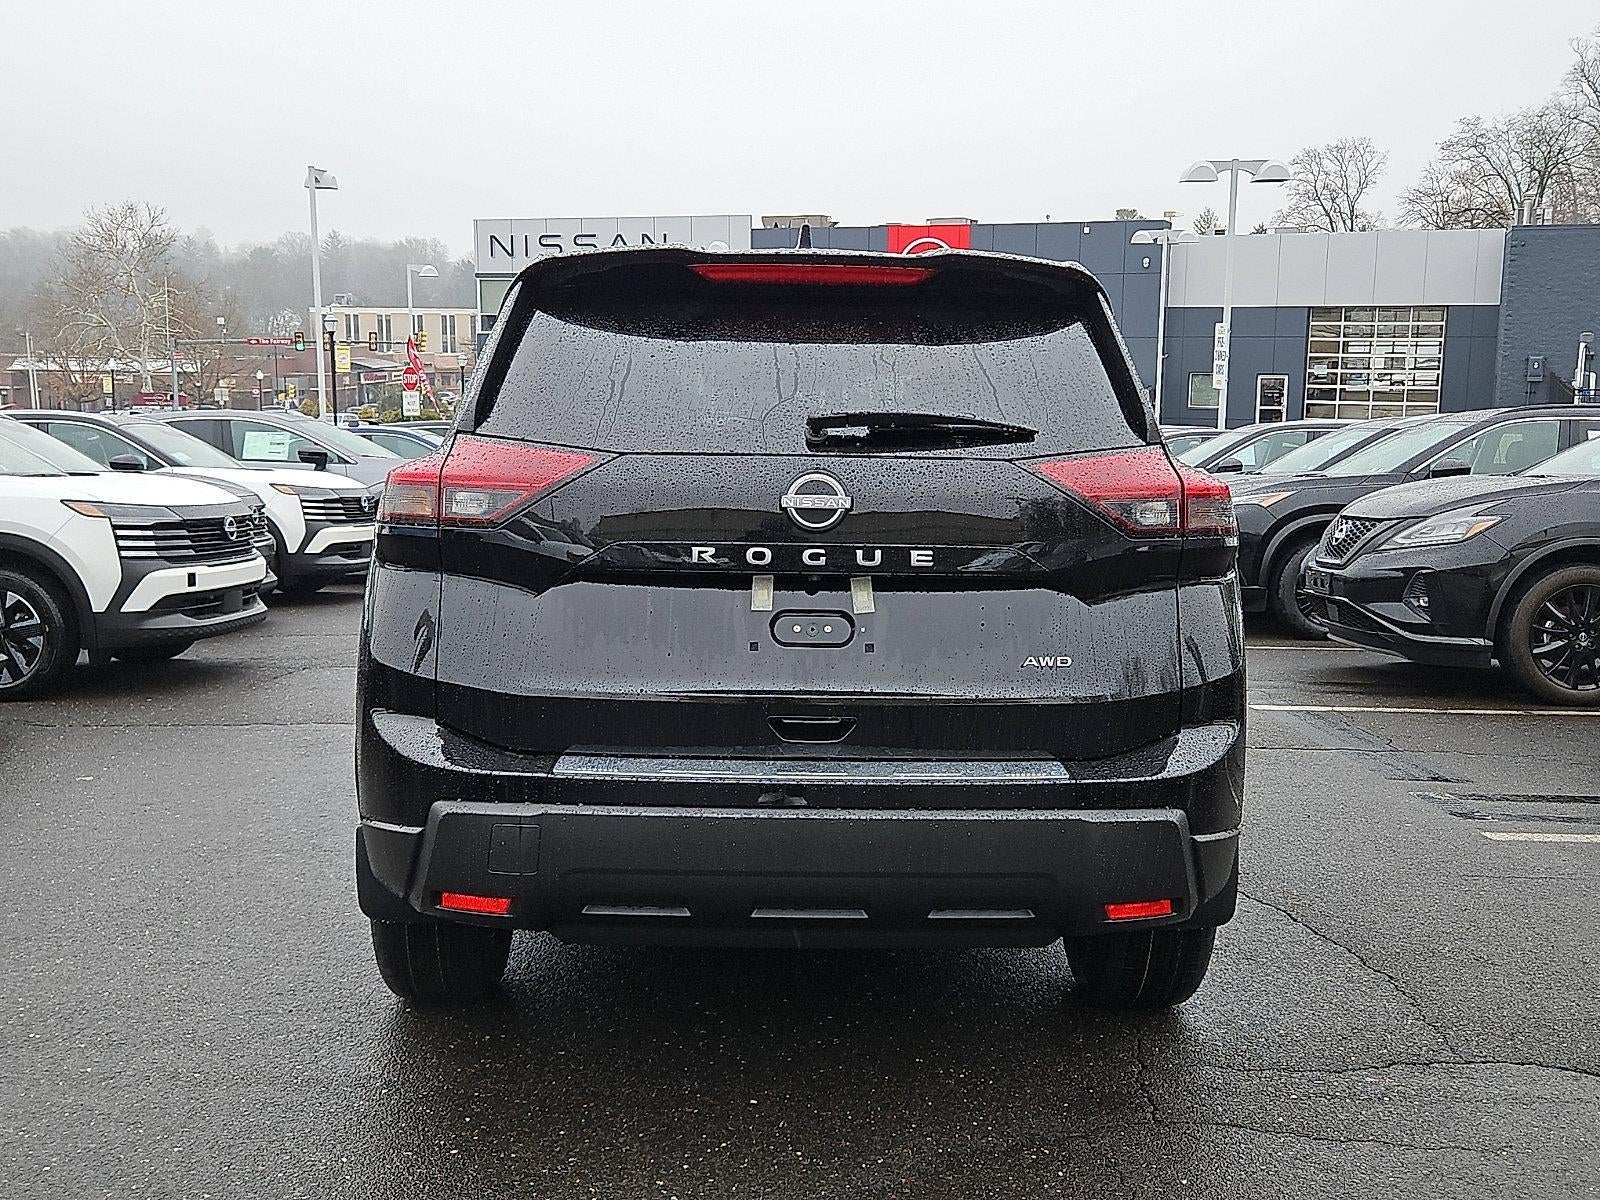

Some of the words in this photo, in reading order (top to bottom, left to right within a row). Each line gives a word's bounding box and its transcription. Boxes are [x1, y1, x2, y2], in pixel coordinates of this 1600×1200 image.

[403, 373, 418, 384] STOP
[783, 496, 849, 508] NISSAN
[691, 546, 934, 566] ROGUE
[1021, 656, 1072, 667] AWD
